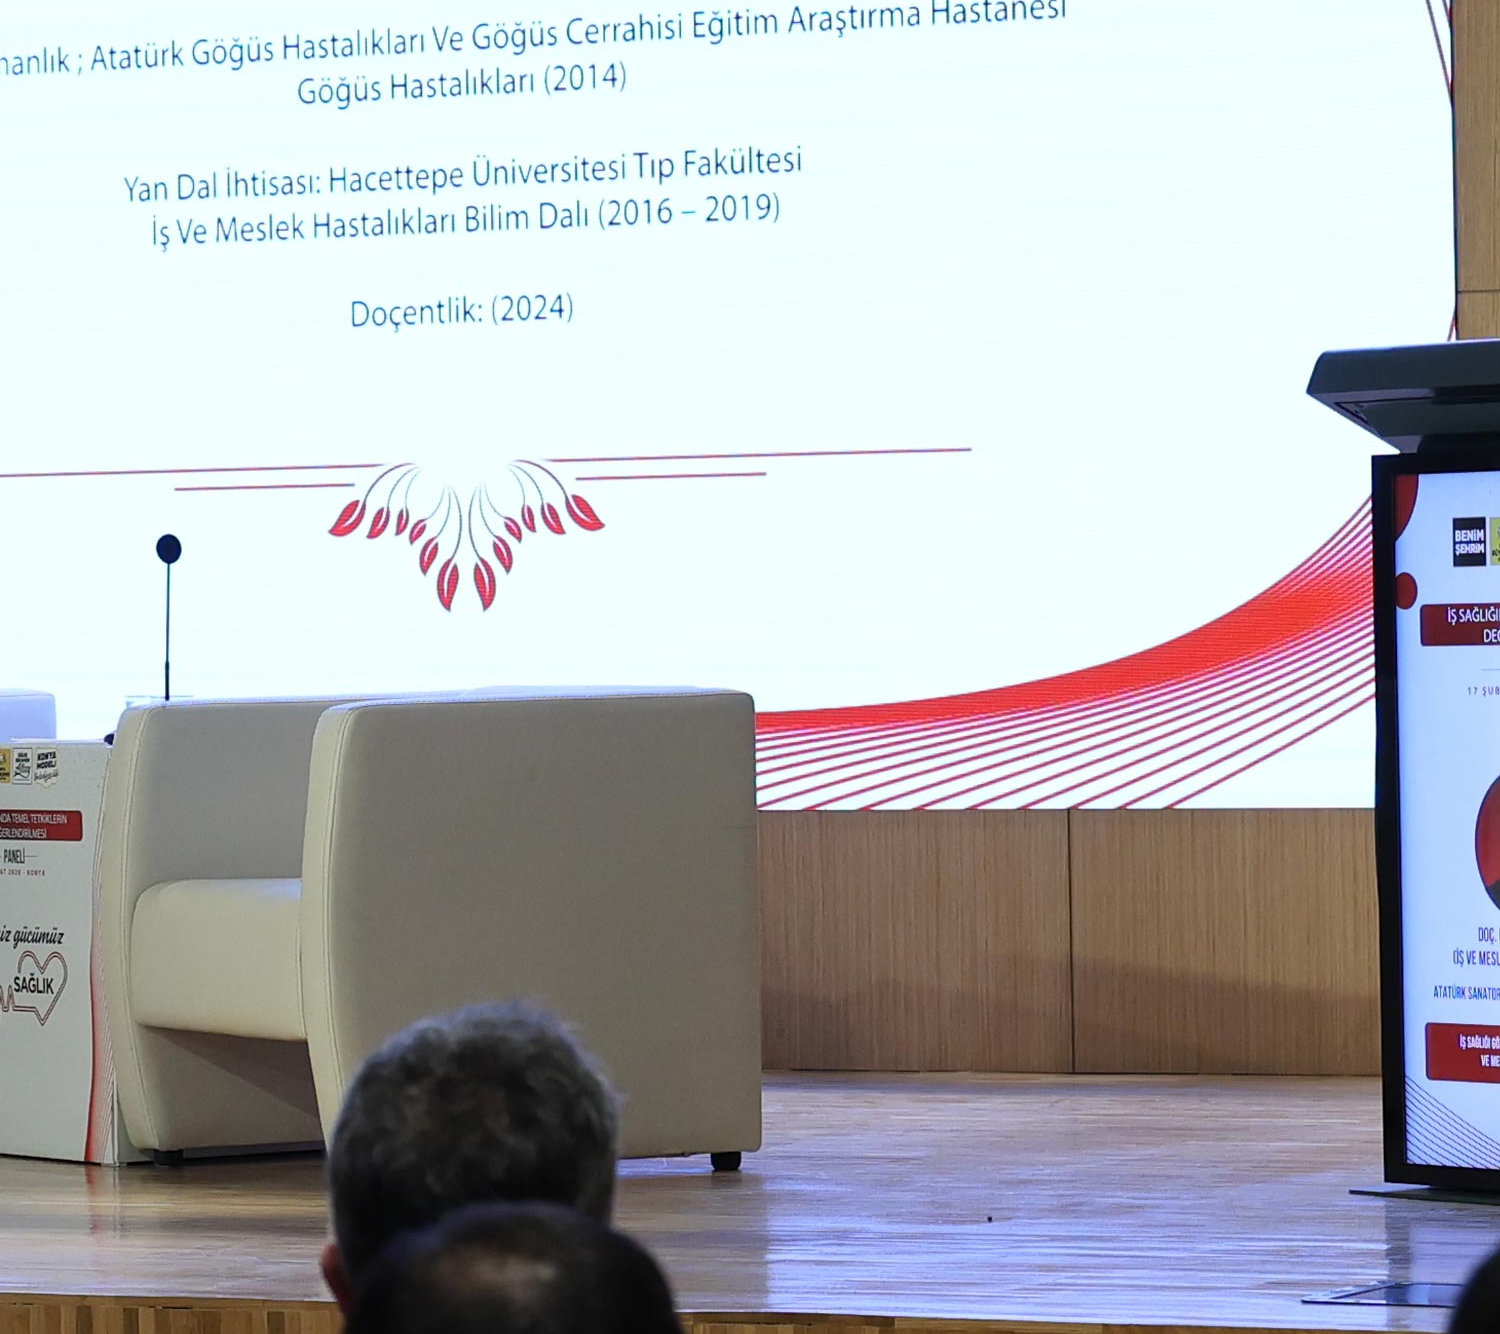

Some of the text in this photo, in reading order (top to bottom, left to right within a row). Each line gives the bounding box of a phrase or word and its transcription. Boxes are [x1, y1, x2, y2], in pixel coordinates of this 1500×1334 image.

[91, 40, 184, 70] Atatürk
[192, 37, 273, 71] Göğüs
[283, 28, 424, 59] Hastalıkları
[432, 26, 463, 52] Ve
[472, 21, 557, 56] Göğüs
[567, 13, 681, 44] Cerrahisi
[693, 9, 778, 45] Eğitim
[788, 6, 920, 38] Araştırma
[298, 62, 626, 110] Göğüs Hastalıkları (2014)
[124, 146, 801, 202] Yan Dal İhtisası: Hacettepe Üniversitesi Tıp Fakültesi
[153, 193, 779, 252] İş Ve Meslek Hastalıkları Bilim Dalı (2016 2019)
[352, 293, 572, 333] Doçentlik: (2024)
[1455, 529, 1484, 542] BENİM
[1448, 607, 1457, 626] İŞ
[1467, 687, 1478, 695] 17
[4, 848, 25, 864] PANELİ
[13, 926, 65, 949] gücümüz
[1478, 927, 1497, 945] DOÇ.
[1466, 951, 1477, 965] VE
[13, 972, 55, 994] SAĞLIK
[1434, 984, 1466, 999] ATATÜRK
